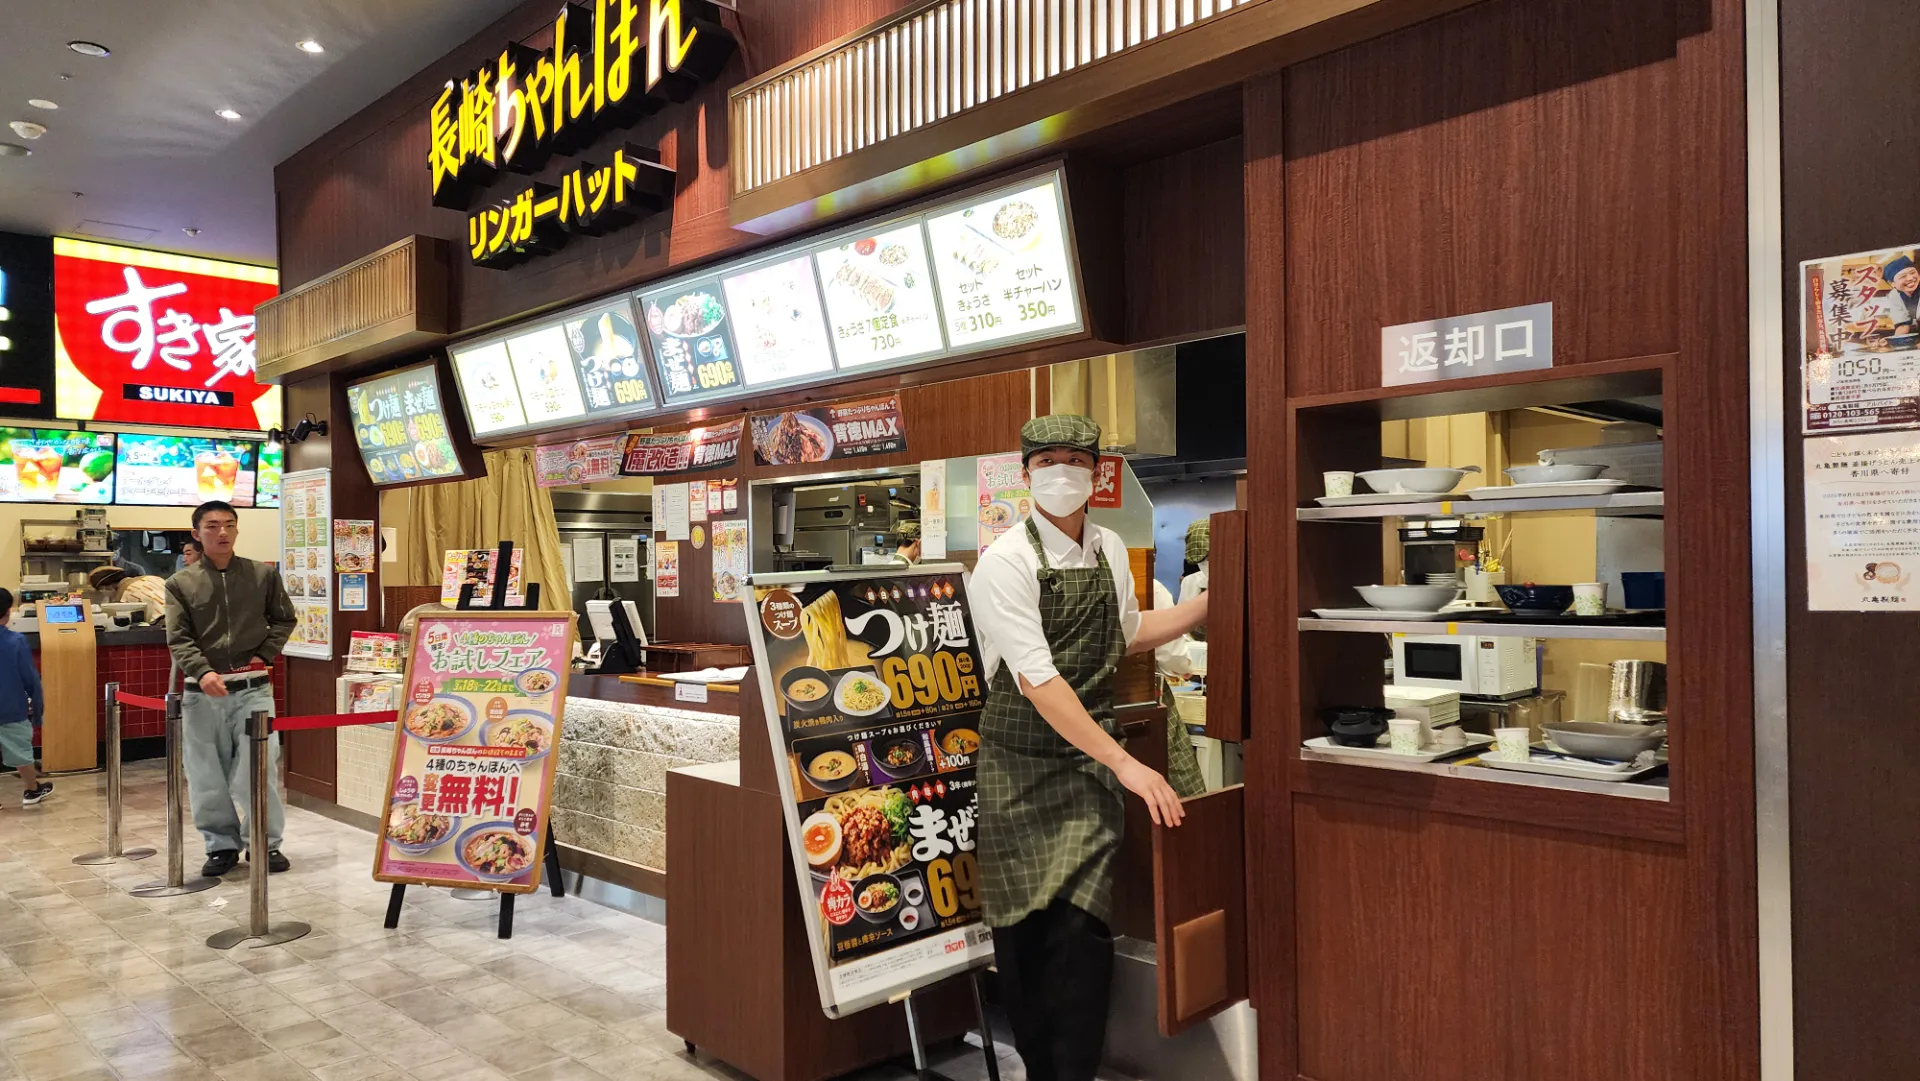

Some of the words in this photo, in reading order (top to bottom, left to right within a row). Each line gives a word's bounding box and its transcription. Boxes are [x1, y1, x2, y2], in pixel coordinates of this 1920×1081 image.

[469, 150, 637, 260] リンガーハット
[1015, 264, 1043, 280] セット
[959, 278, 983, 294] セット
[1003, 278, 1062, 301] 半チャーハン
[1018, 300, 1056, 322] 350円
[1854, 266, 1880, 340] スタッフ
[969, 312, 1002, 332] 310円
[1829, 278, 1852, 351] 募集中
[86, 266, 256, 387] すき家
[1398, 319, 1534, 373] 返却口
[139, 386, 220, 405] SUKIYA
[1823, 409, 1880, 418] 0120-103-565
[832, 416, 899, 443] 背徳MAX
[1815, 461, 1848, 470] 丸亀製麺
[1851, 467, 1909, 478] 香川県へ寄付
[1861, 596, 1900, 604] 丸亀製麺
[773, 617, 799, 631] スープ
[845, 600, 969, 657] つけ麺
[432, 649, 549, 673] お試しフェア
[882, 651, 980, 709] 690円
[426, 758, 520, 774] 4種のちゃんぽんへ
[939, 753, 971, 769] +100円
[420, 773, 440, 812] 変更
[436, 774, 519, 816] 無料!
